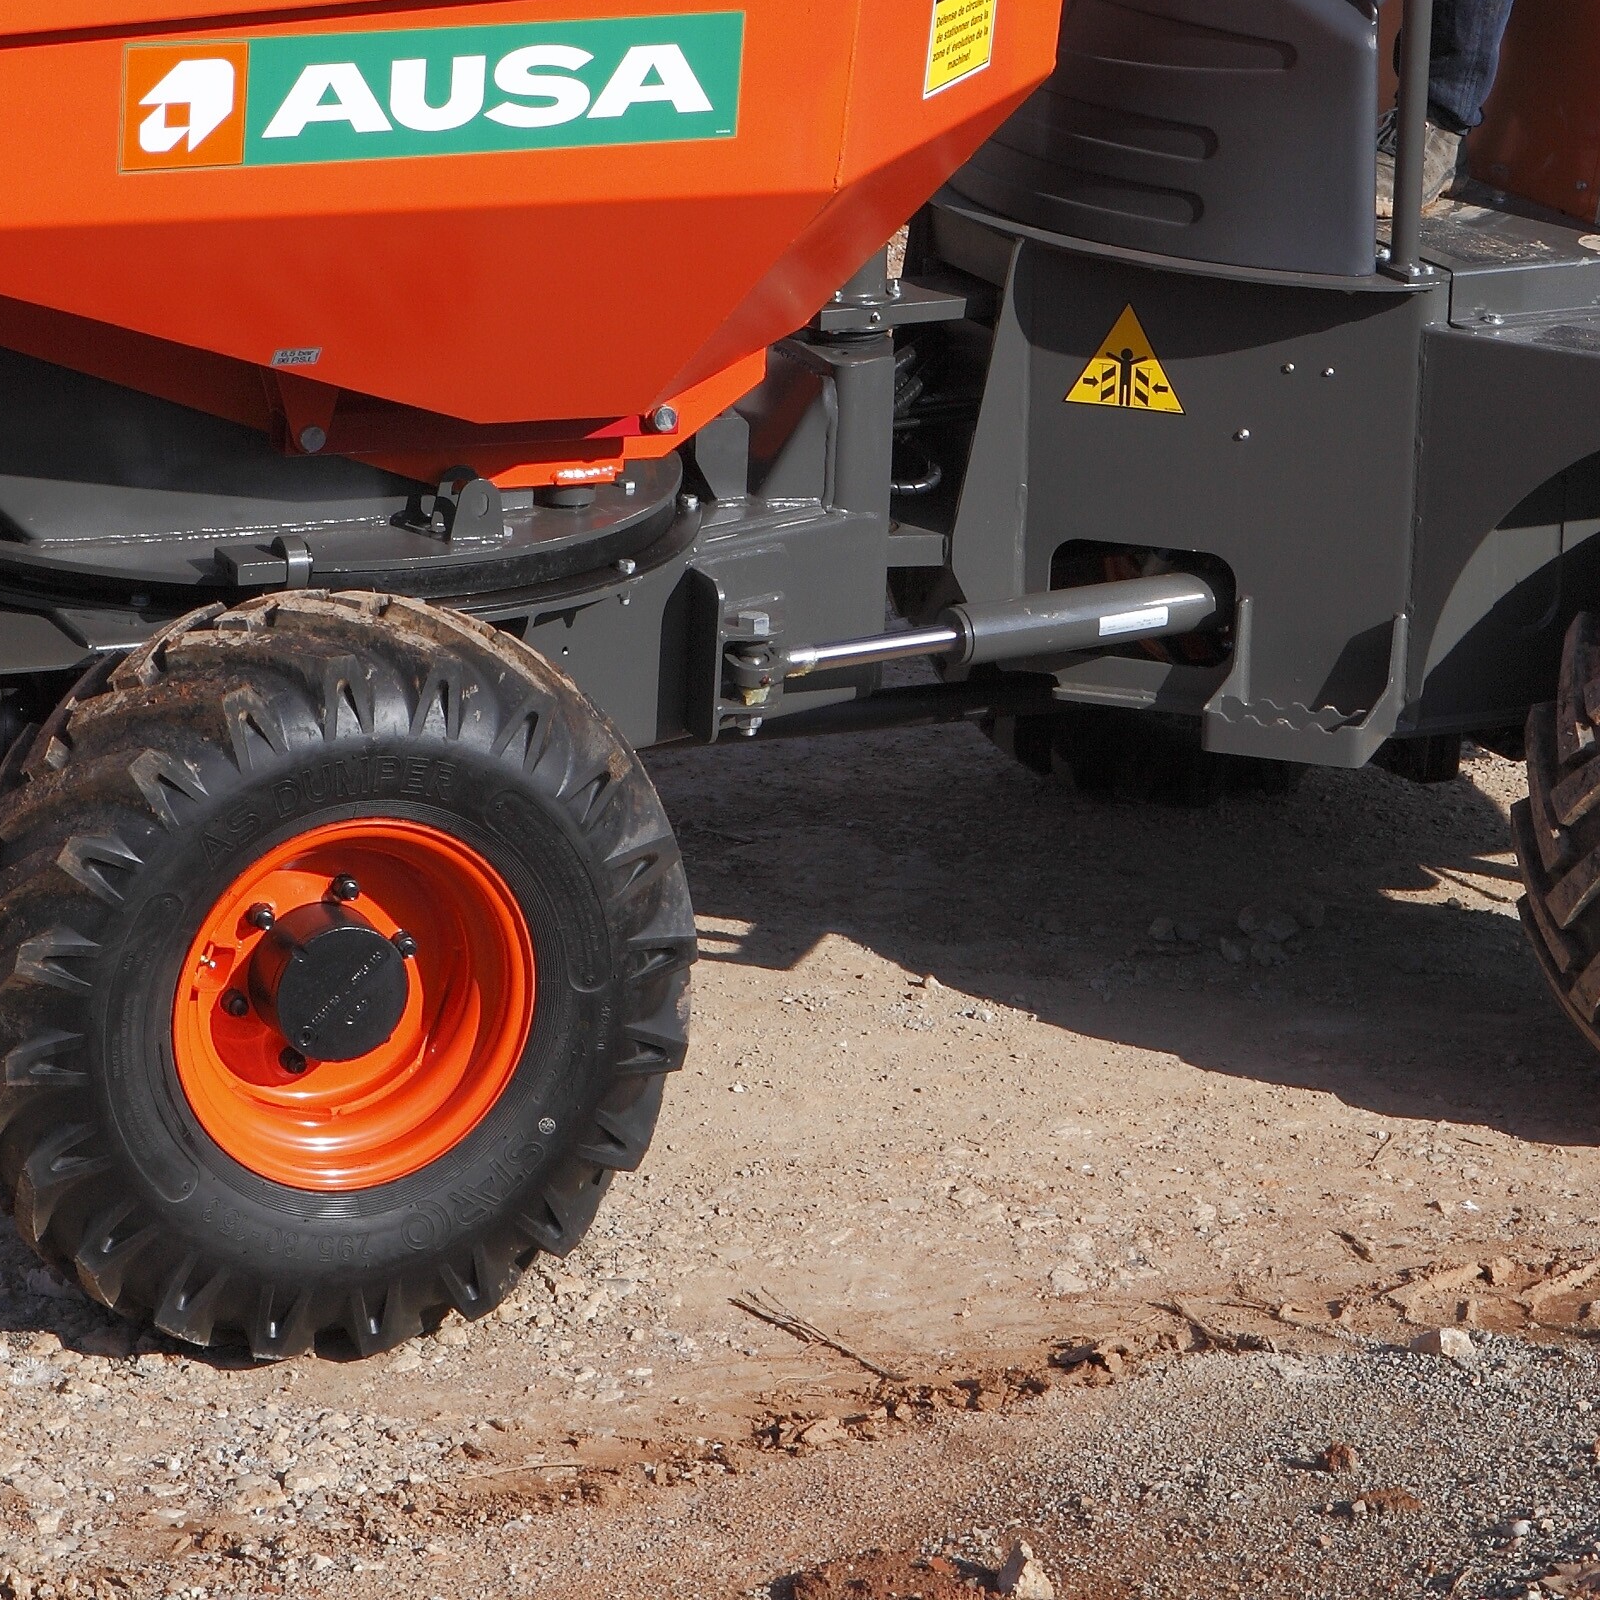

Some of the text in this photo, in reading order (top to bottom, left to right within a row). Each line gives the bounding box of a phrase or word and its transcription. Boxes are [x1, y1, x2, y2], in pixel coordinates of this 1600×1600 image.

[958, 5, 965, 17] de
[936, 33, 943, 44] de
[970, 13, 983, 27] dans
[975, 28, 983, 40] de
[260, 42, 713, 140] AUSA
[198, 755, 456, 870] AS DUMPER
